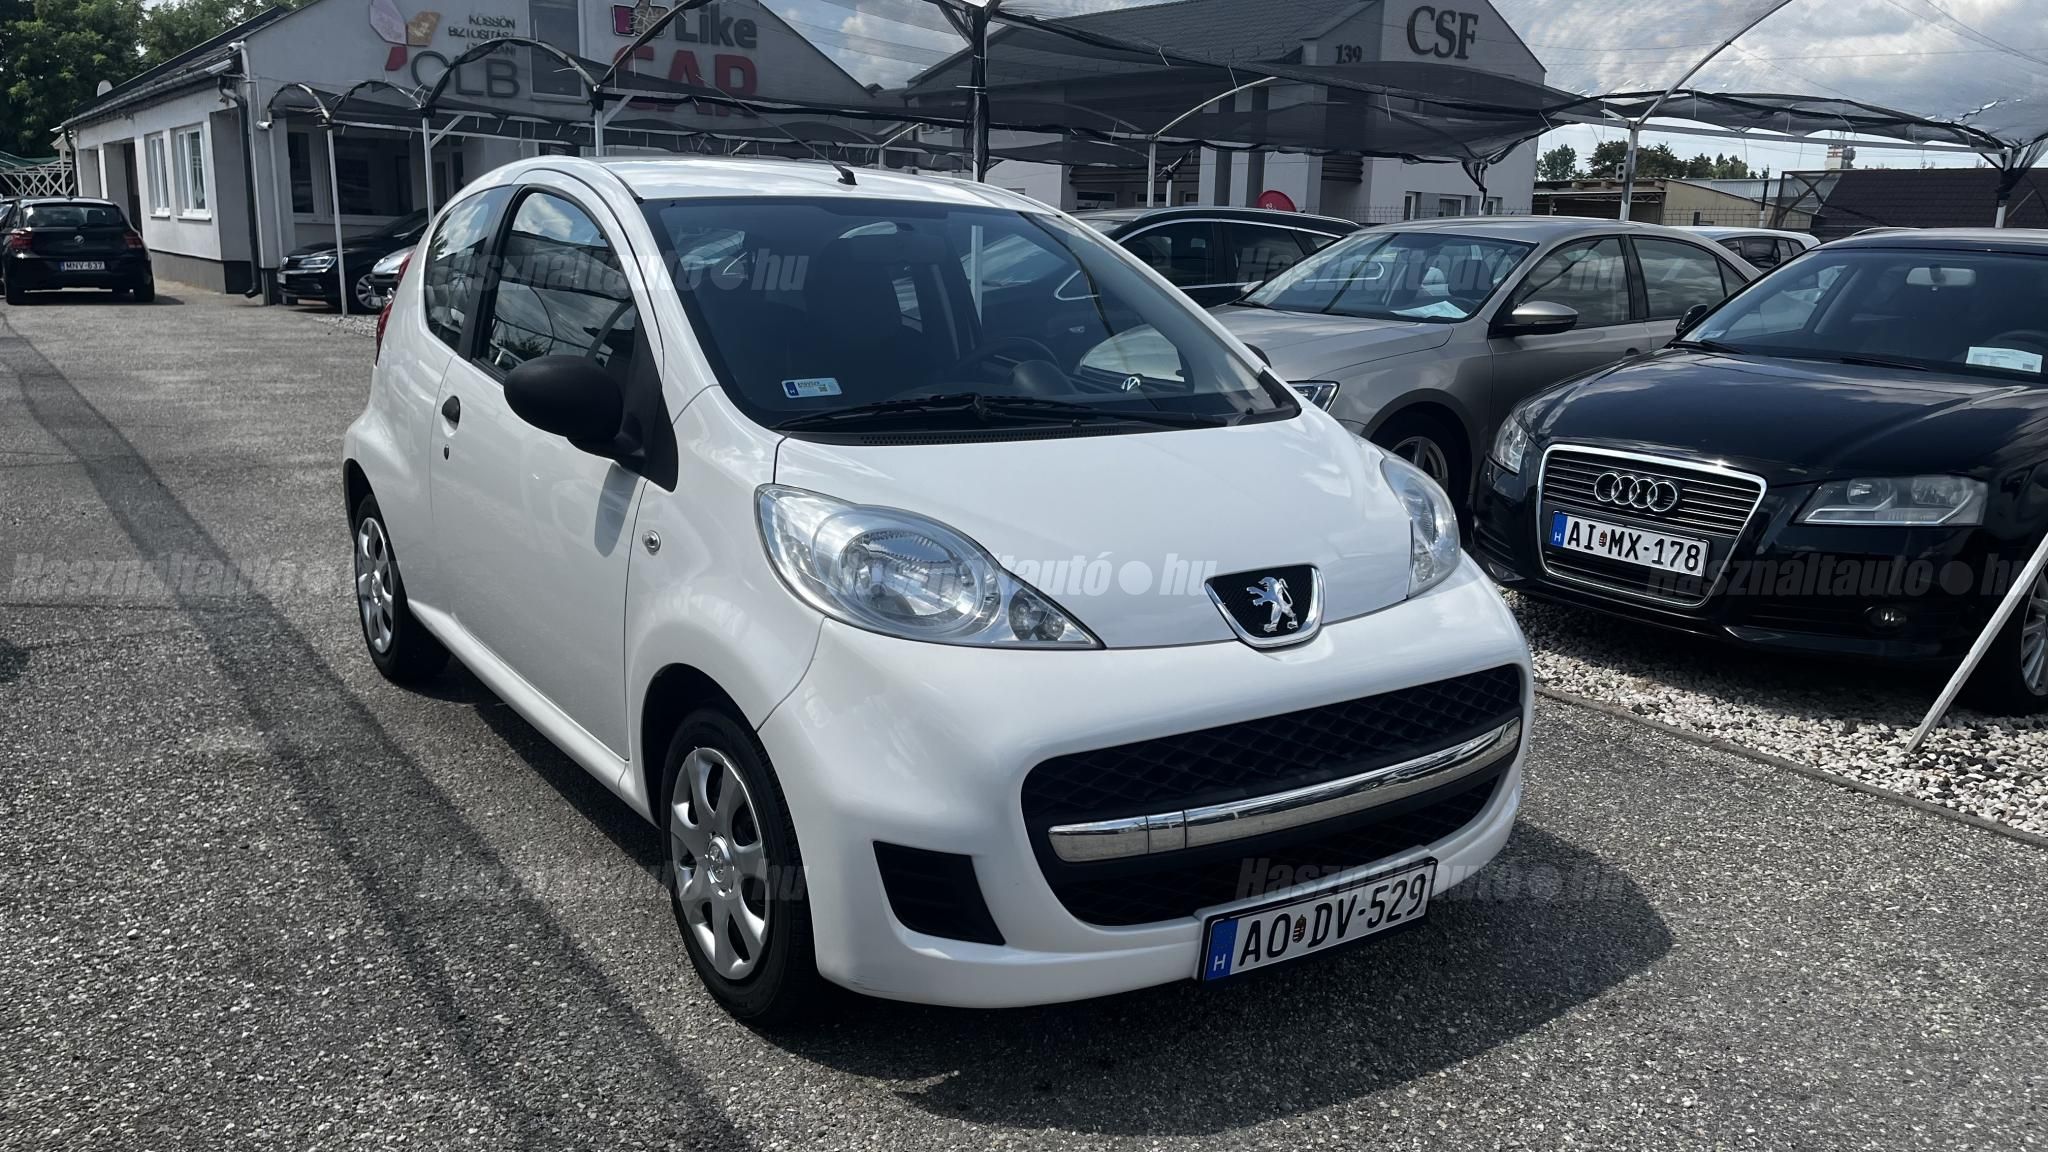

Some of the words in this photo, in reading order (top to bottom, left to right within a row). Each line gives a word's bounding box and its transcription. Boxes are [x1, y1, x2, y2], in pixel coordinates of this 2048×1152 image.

[675, 0, 757, 48] Like
[1406, 6, 1479, 60] CSF
[1335, 44, 1363, 65] 139
